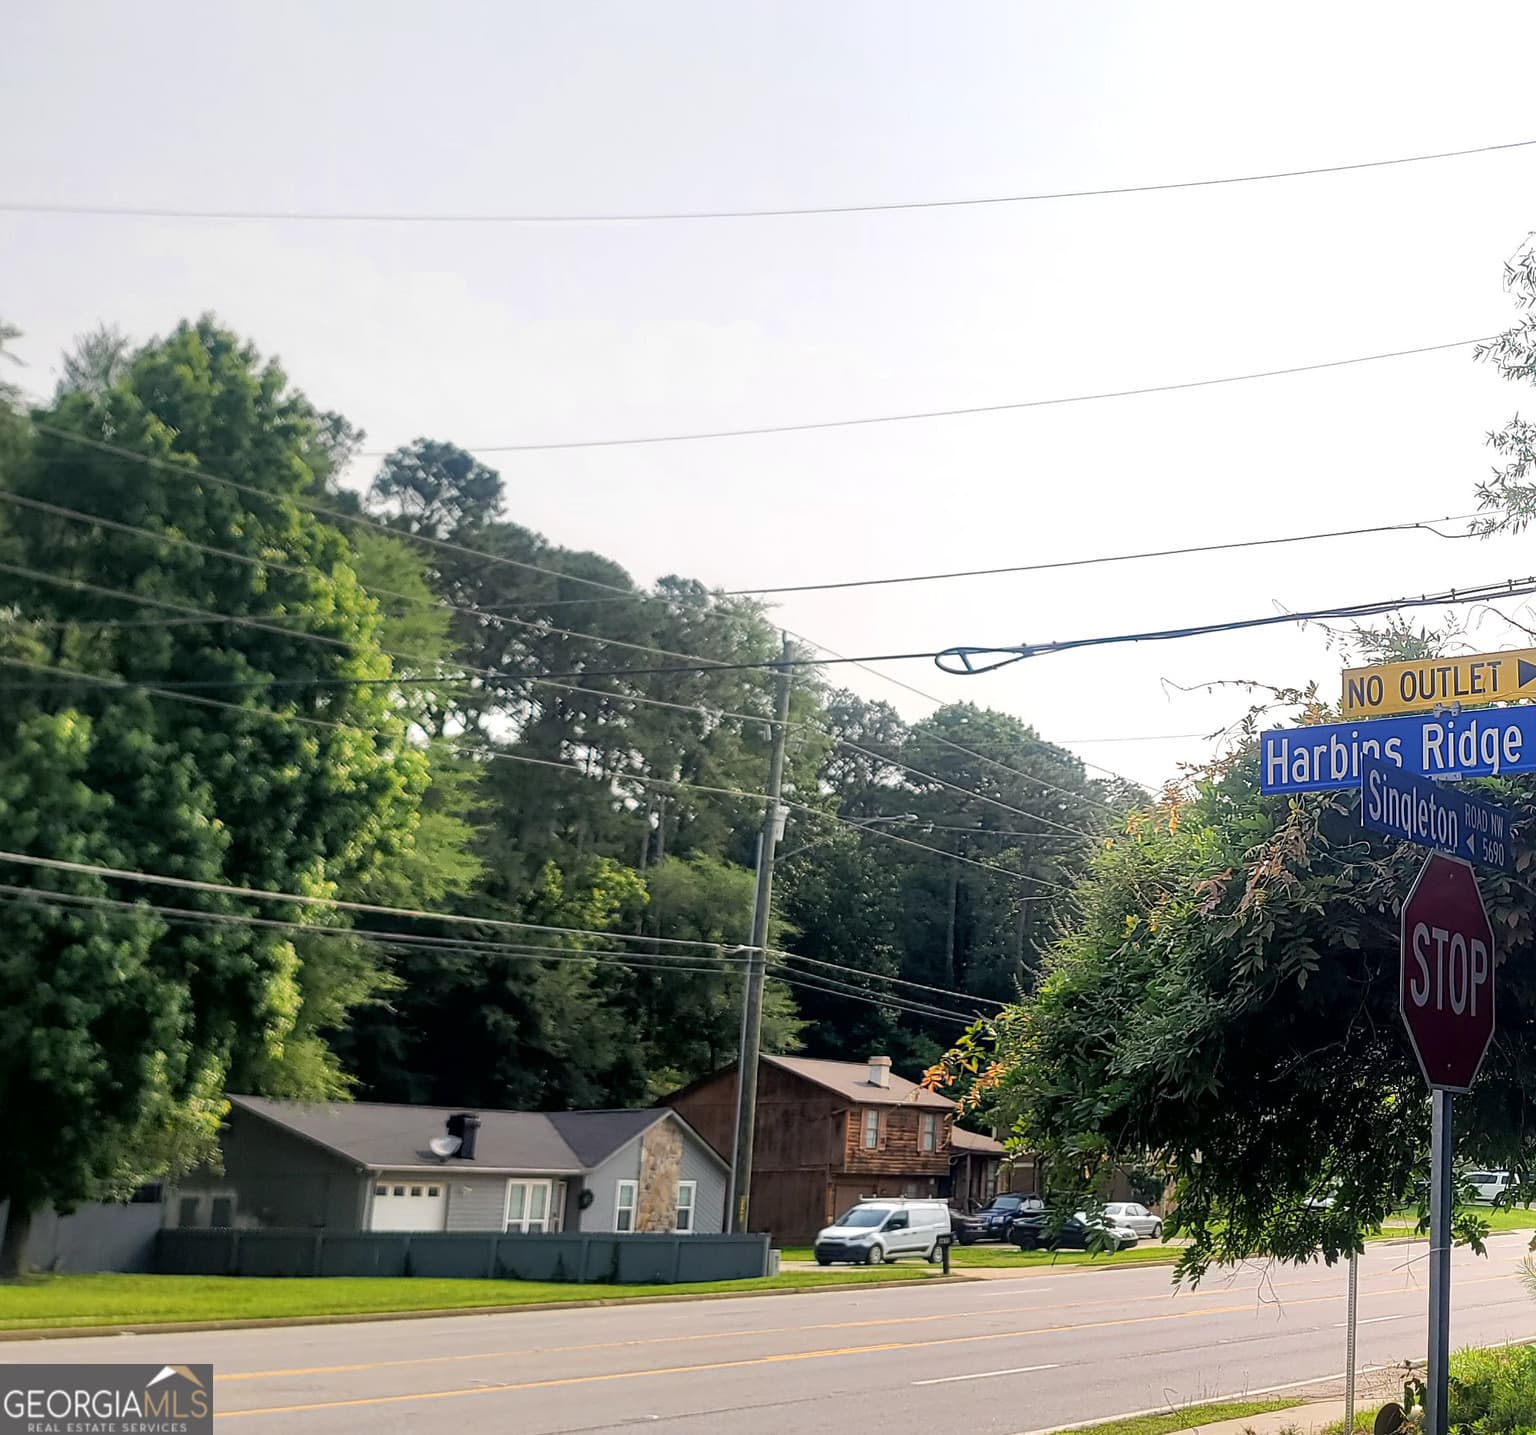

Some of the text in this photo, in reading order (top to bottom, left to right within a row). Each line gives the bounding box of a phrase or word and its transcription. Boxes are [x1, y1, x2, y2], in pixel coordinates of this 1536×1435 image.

[1347, 661, 1501, 709] NO OUTLET
[1422, 720, 1523, 775] Ridge
[1368, 769, 1458, 847] Singleton
[1464, 803, 1504, 840] ROAD NW
[1482, 837, 1504, 866] 5690
[1410, 922, 1488, 1017] STOP
